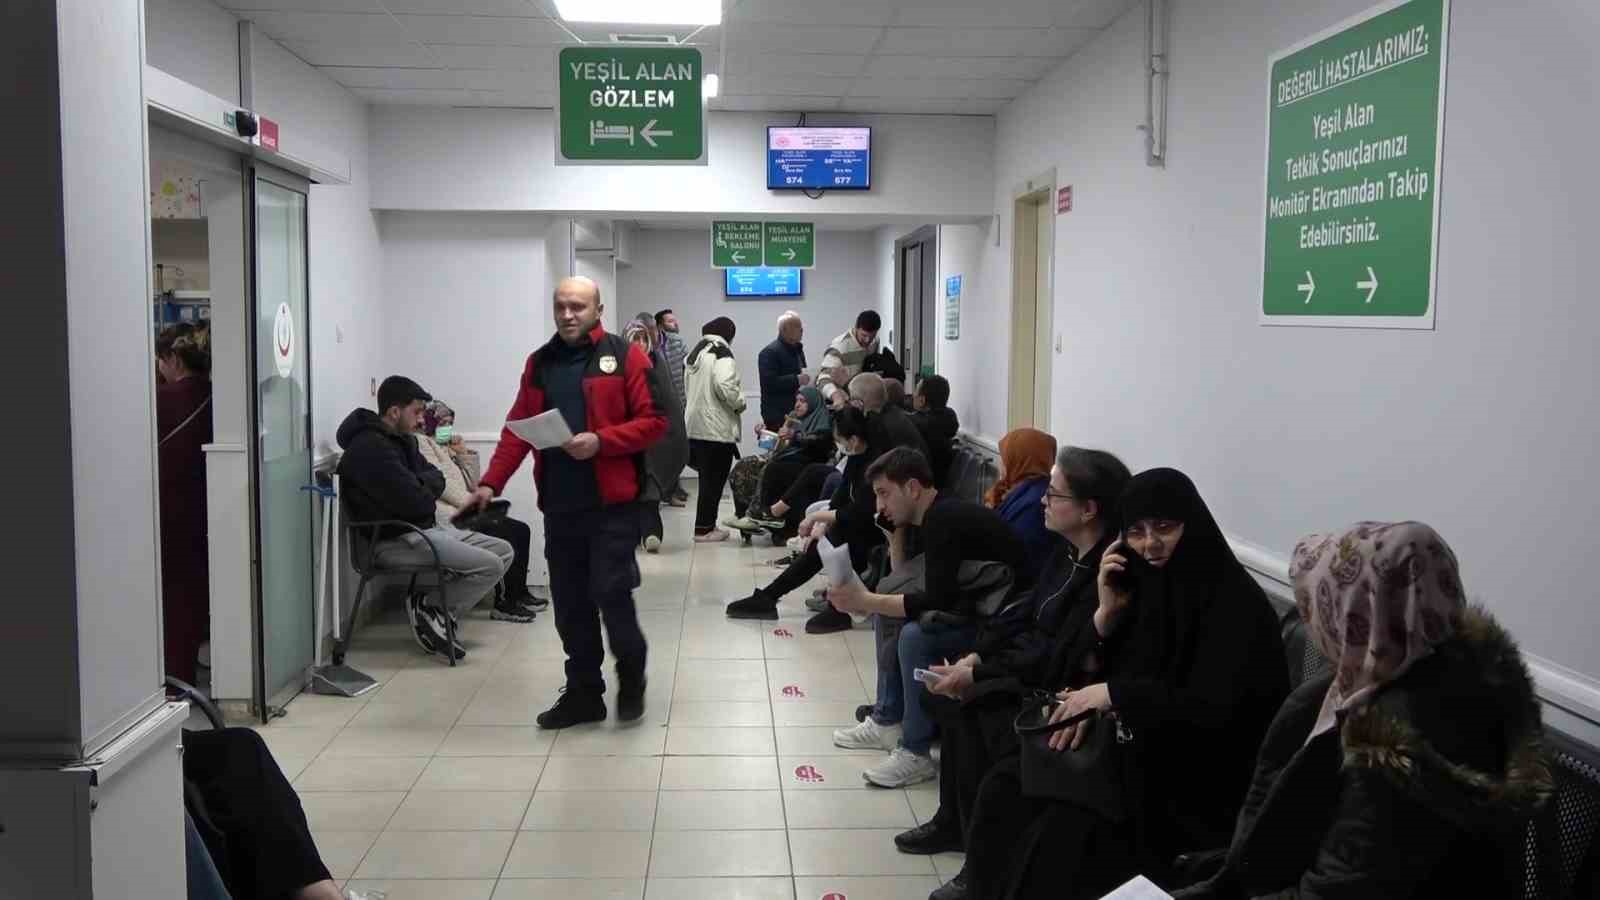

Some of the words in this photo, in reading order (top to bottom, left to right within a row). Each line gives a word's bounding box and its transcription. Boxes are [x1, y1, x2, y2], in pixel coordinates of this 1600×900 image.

[570, 58, 630, 83] YEŞİL
[635, 62, 693, 81] ALAN
[1278, 59, 1324, 103] DEĞERLİ
[1326, 25, 1429, 85] HASTALARIMIZ;
[589, 85, 675, 108] GÖZLEM
[1313, 107, 1342, 139] Yeşil
[1344, 103, 1375, 131] Alan
[1286, 154, 1320, 182] Tetkik
[1322, 135, 1408, 173] Sonuçlarınızı
[1270, 191, 1310, 219] Monitör
[1312, 178, 1384, 211] Ekranından
[1388, 168, 1429, 200] Takip
[741, 223, 760, 231] ALAN
[768, 225, 788, 233] YEŞİL
[771, 235, 808, 243] MUAYENE
[1300, 217, 1380, 249] Edebilirsiniz.
